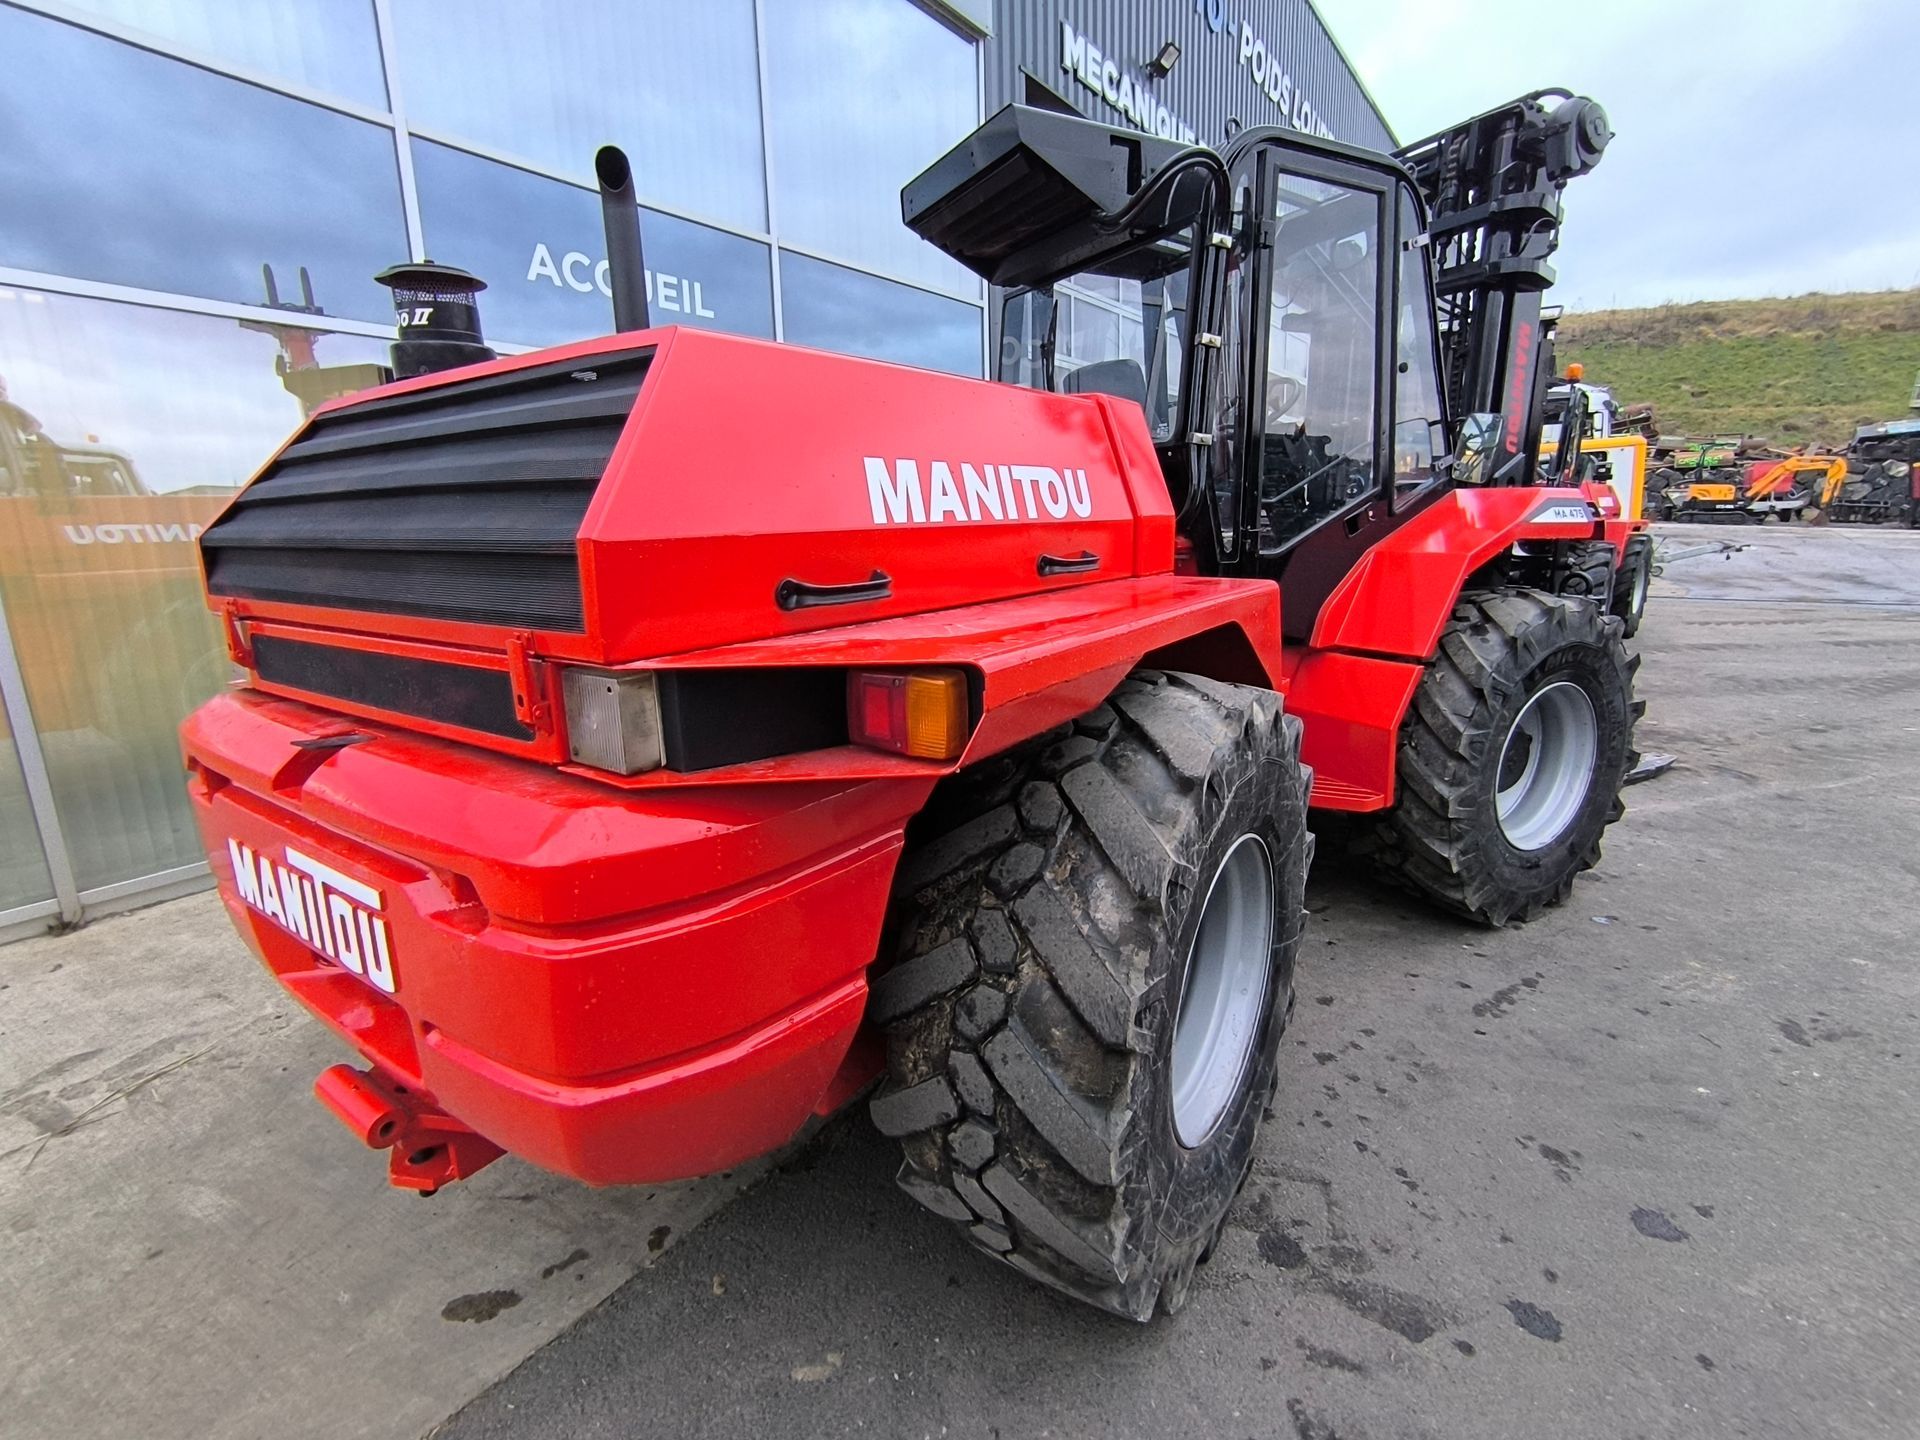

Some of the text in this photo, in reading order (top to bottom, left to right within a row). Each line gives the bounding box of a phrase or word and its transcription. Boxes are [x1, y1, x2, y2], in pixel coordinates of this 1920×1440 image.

[1239, 20, 1291, 115] POIDS
[863, 456, 1092, 524] MANITOU
[1554, 508, 1584, 519] MA 475
[228, 837, 396, 993] MANITOU
